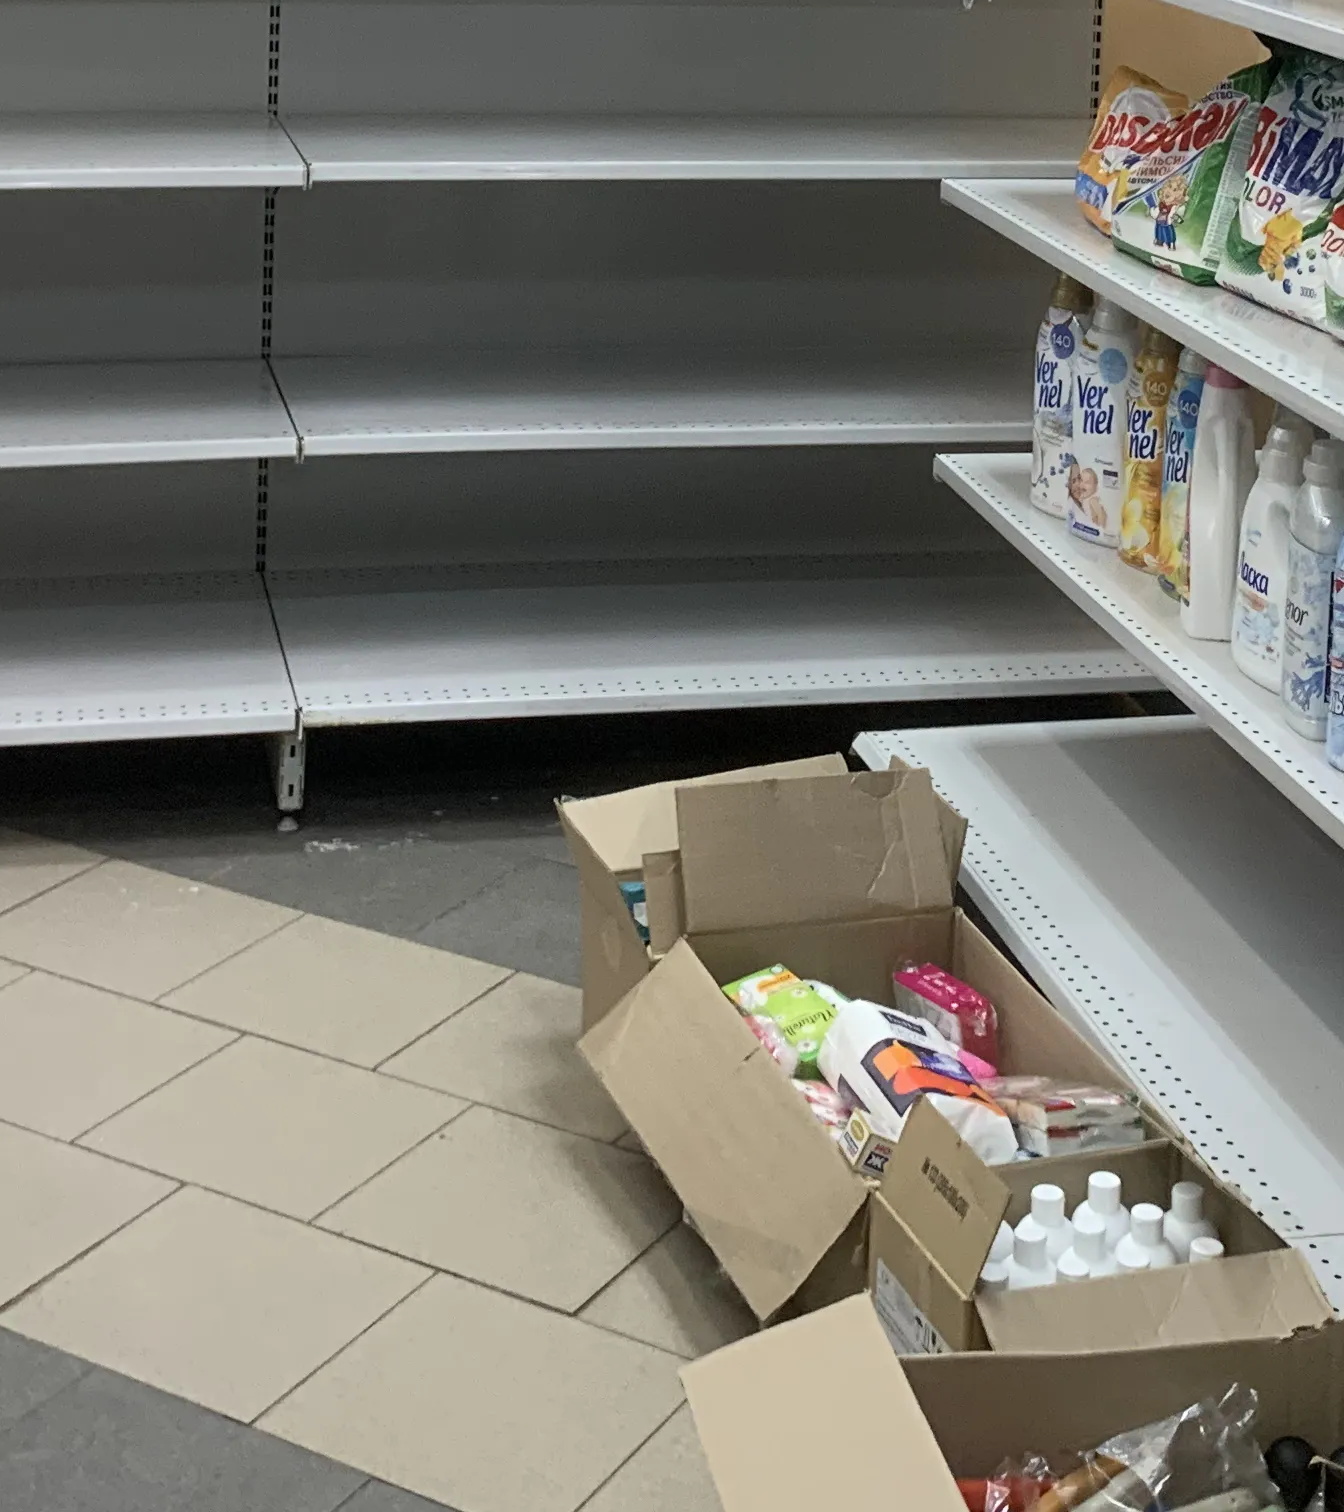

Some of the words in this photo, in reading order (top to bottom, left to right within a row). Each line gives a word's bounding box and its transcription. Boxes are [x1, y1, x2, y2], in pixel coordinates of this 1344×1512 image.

[1243, 177, 1287, 214] OLOR
[1051, 333, 1072, 348] 140
[1036, 352, 1058, 385] Ver
[1038, 379, 1063, 408] nel
[1077, 375, 1109, 410] Ver
[1178, 399, 1199, 417] 140
[1082, 404, 1115, 435] nel
[1126, 399, 1153, 434] Ver
[1129, 429, 1158, 460] nel
[1165, 419, 1185, 456] Ver
[1166, 451, 1189, 484] nel
